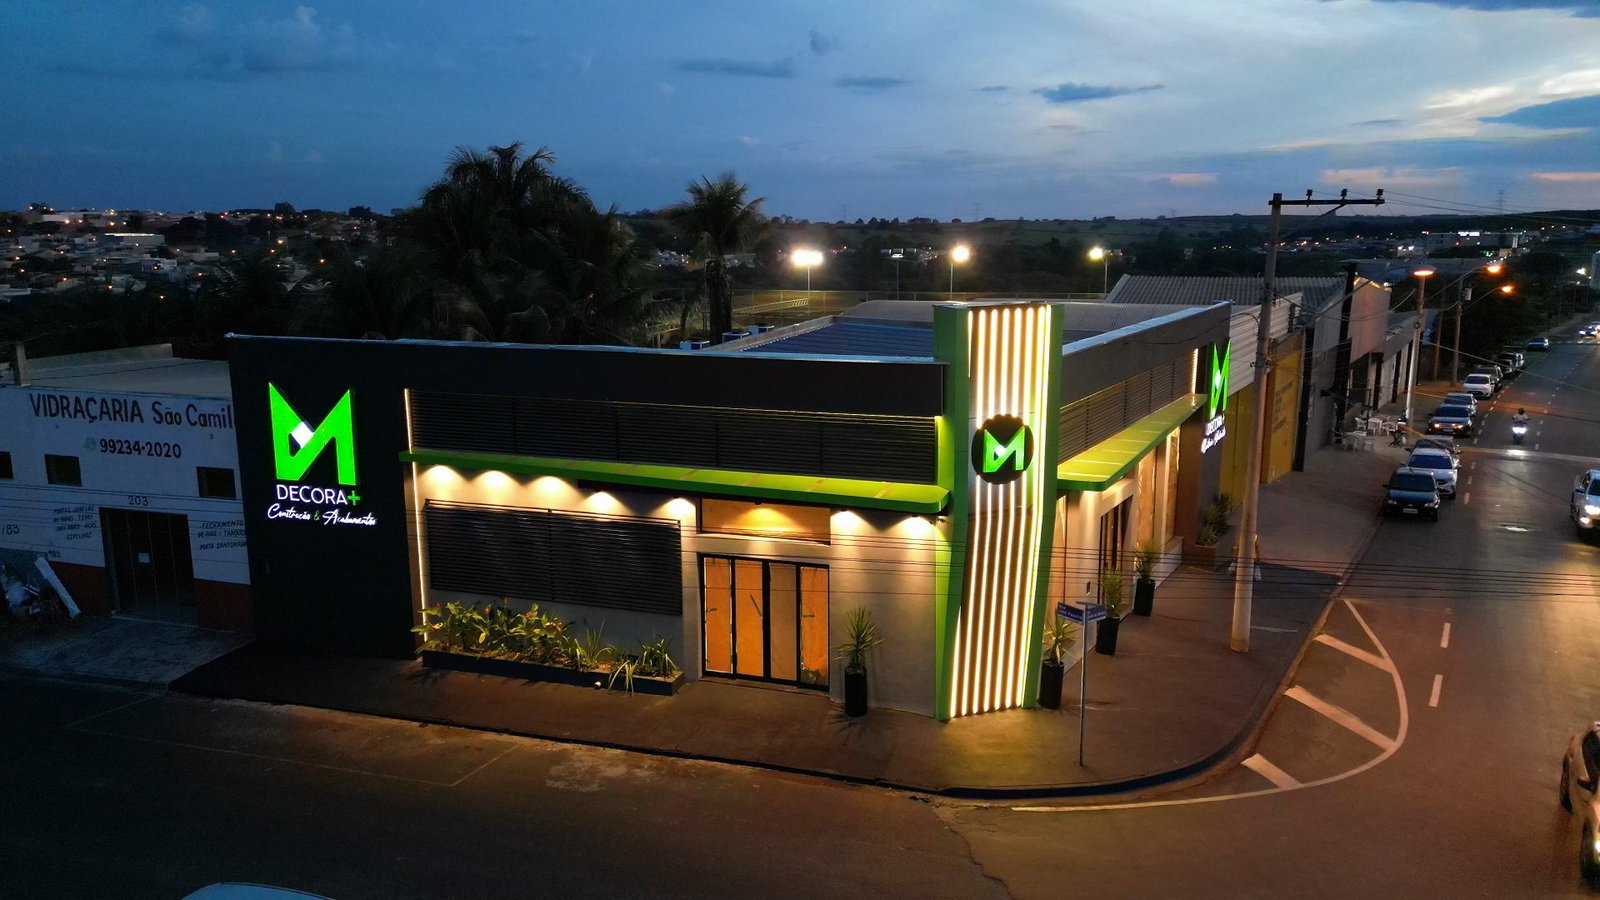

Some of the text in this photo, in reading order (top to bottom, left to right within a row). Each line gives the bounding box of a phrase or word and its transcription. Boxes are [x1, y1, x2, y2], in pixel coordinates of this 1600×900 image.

[29, 393, 144, 423] VIDRAÇARIA
[152, 401, 182, 426] São
[128, 495, 149, 506] 203
